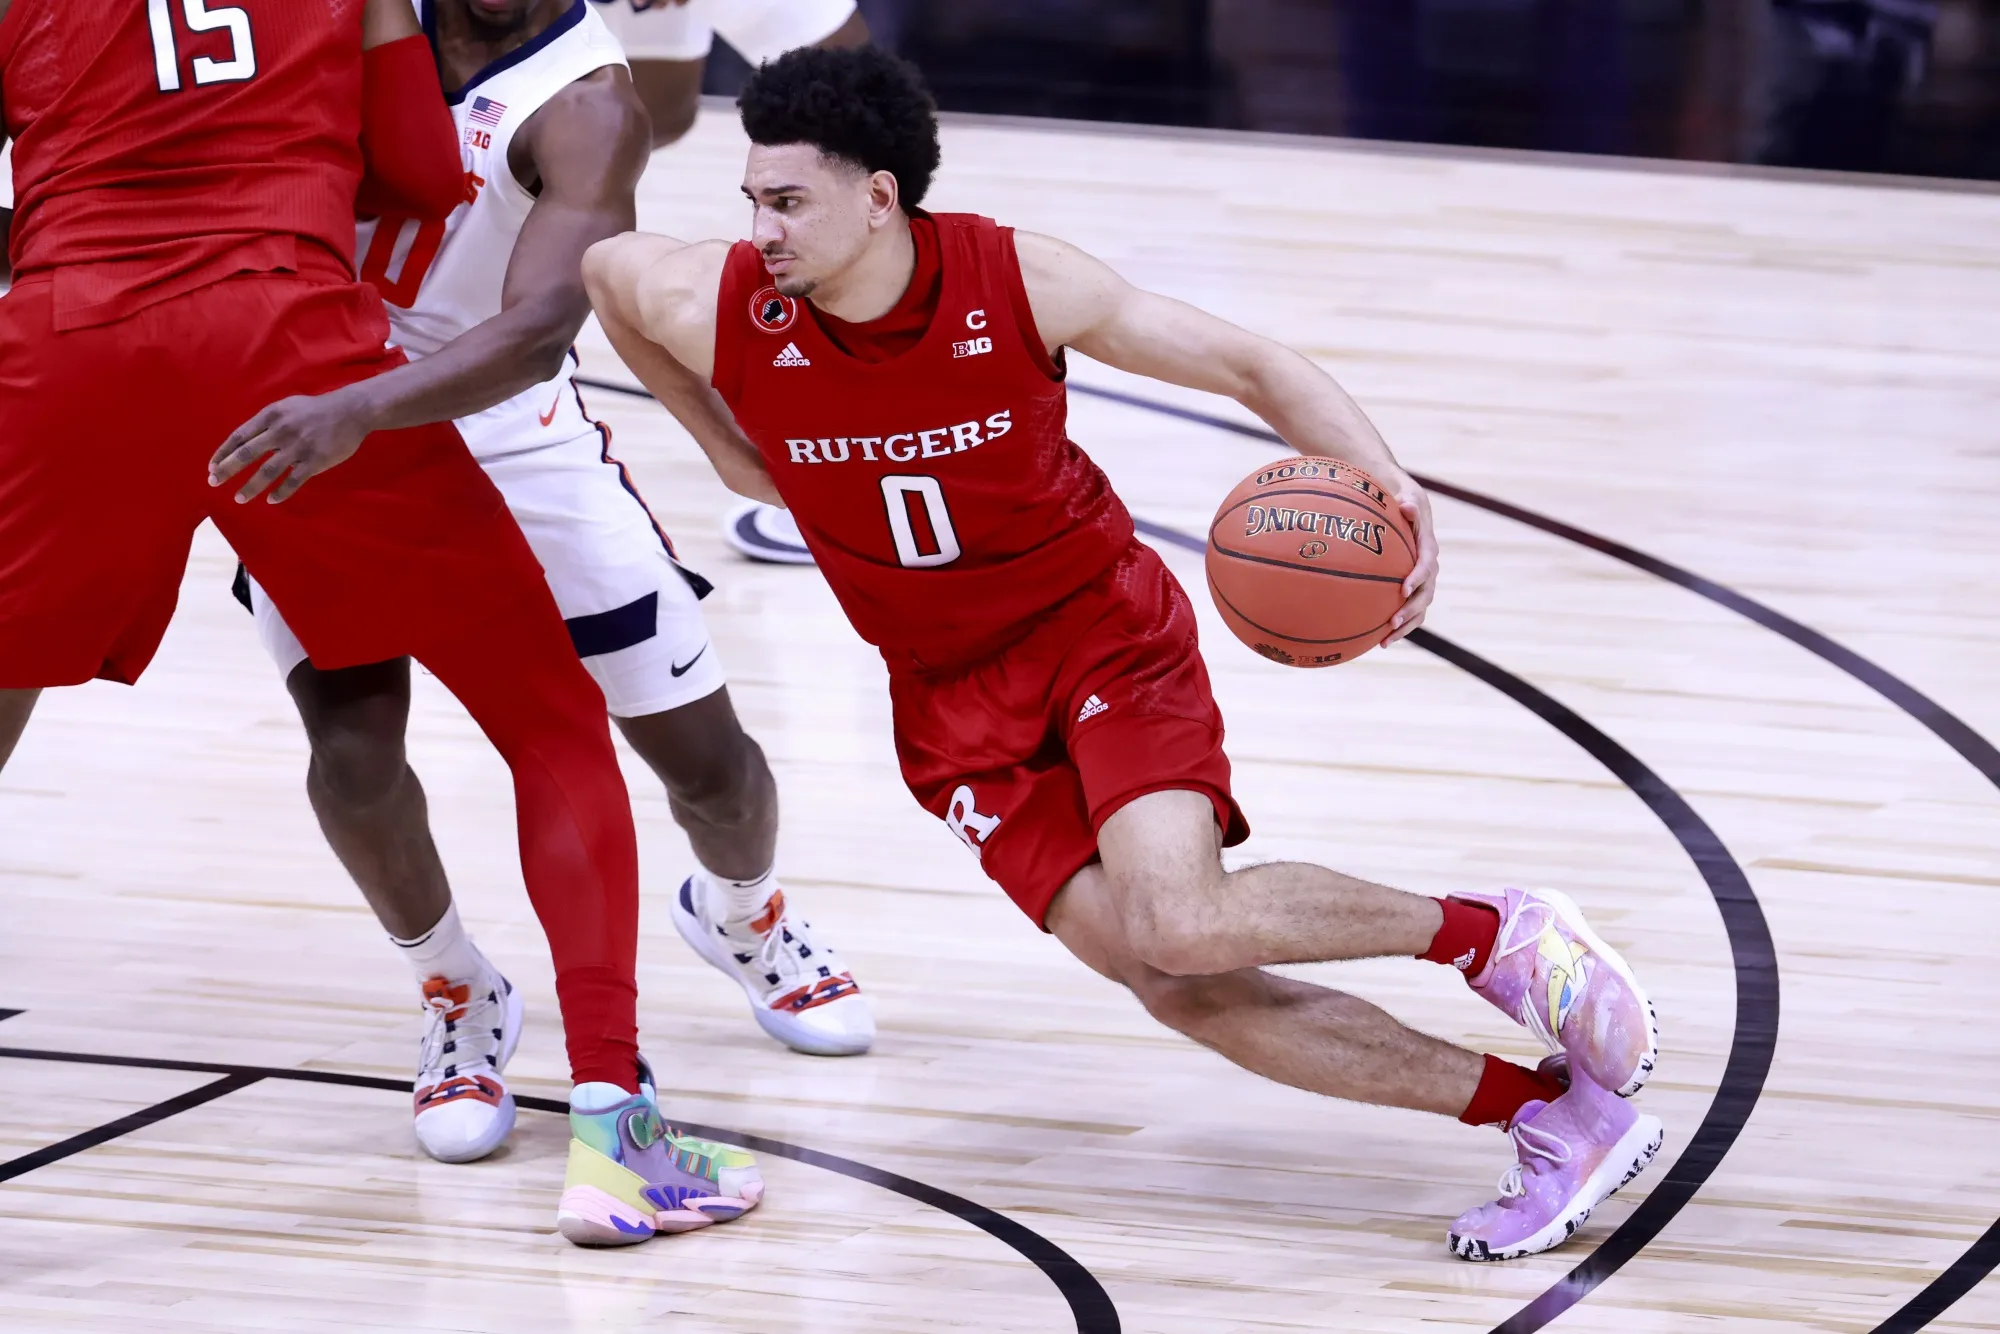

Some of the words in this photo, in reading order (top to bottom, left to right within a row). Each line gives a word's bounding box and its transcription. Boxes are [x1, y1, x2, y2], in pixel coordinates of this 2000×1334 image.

[148, 0, 257, 92] 15
[966, 309, 987, 330] C
[773, 358, 811, 367] adidas
[785, 410, 1013, 463] RUTGERS
[879, 473, 961, 568] 0
[1245, 505, 1387, 555] SPALDING
[1078, 702, 1109, 722] adidas
[946, 784, 1001, 859] R
